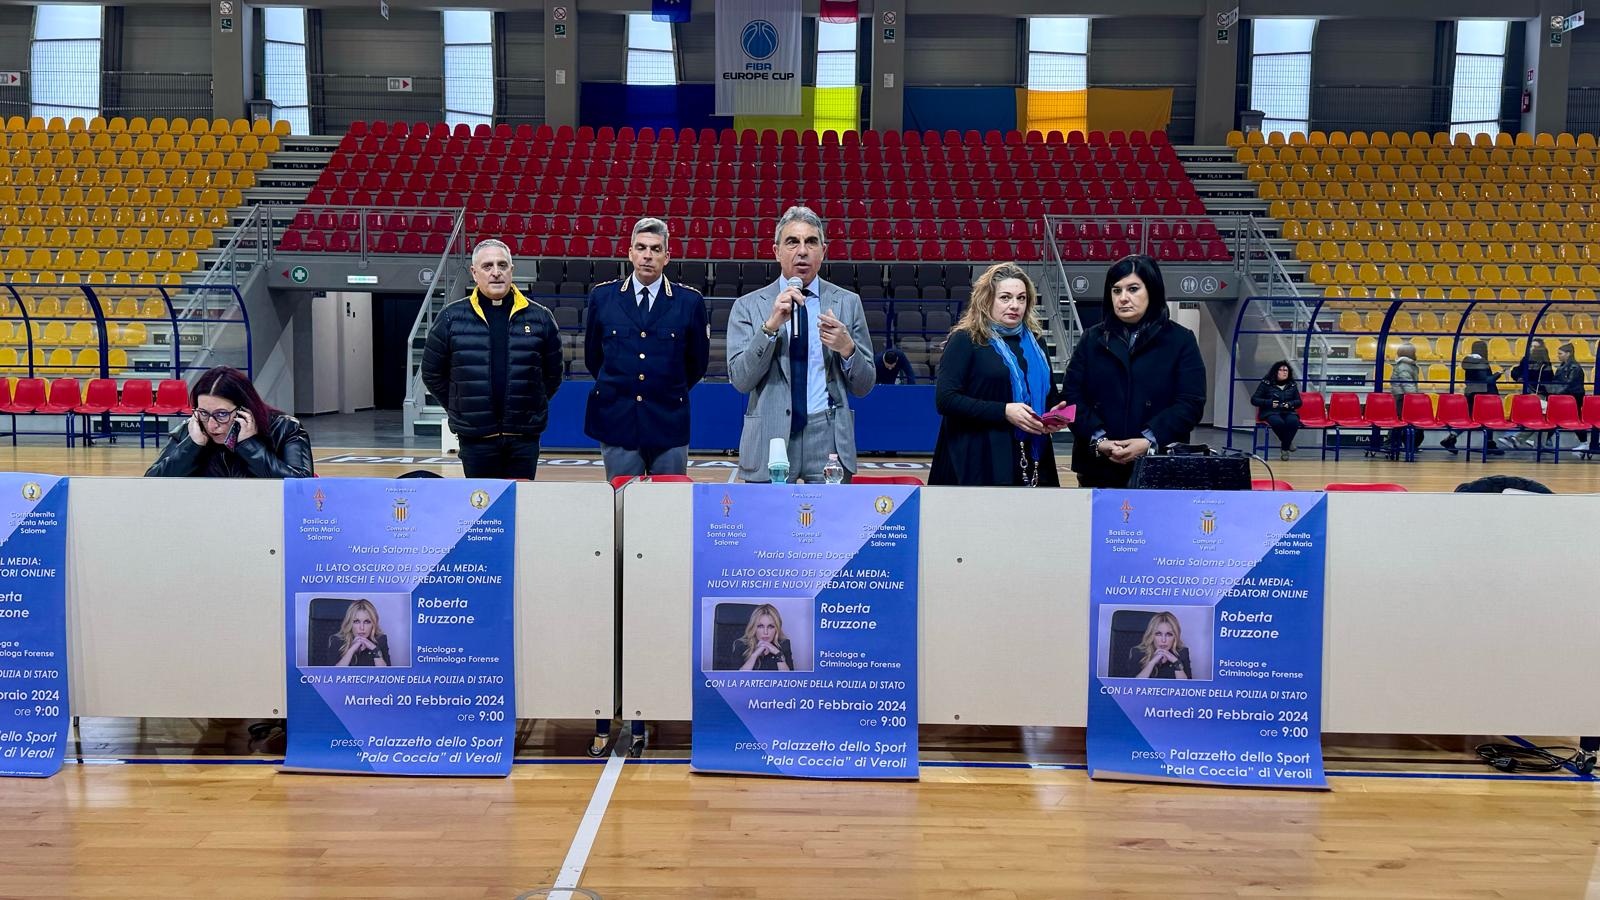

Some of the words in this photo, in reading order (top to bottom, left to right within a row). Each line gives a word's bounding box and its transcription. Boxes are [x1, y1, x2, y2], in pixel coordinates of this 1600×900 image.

[21, 569, 55, 577] ONLINE
[316, 564, 323, 572] IL
[326, 564, 350, 572] LATO
[353, 564, 395, 572] OSCURO
[398, 564, 412, 572] DEI
[415, 564, 451, 572] SOCIAL
[453, 564, 488, 572] MEDIA:
[721, 569, 729, 577] IL
[731, 569, 755, 577] LATO
[758, 569, 799, 577] OSCURO
[801, 569, 816, 577] DEI
[818, 569, 854, 578] SOCIAL
[857, 570, 890, 578] MEDIA:
[301, 576, 334, 584] NUOVI
[337, 576, 368, 584] RISCHI
[370, 576, 375, 584] E
[378, 576, 410, 584] NUOVI
[413, 576, 464, 584] PREDATORI
[467, 576, 502, 584] ONLINE
[707, 580, 739, 588] NUOVI
[741, 580, 772, 589] RISCHI
[774, 581, 779, 589] E
[782, 581, 813, 589] NUOVI
[816, 581, 866, 589] PREDATORI
[869, 581, 904, 590] ONLINE
[1120, 576, 1127, 584] IL
[1130, 576, 1154, 584] LATO
[1157, 576, 1199, 585] OSCURO
[1202, 577, 1217, 585] DEI
[1220, 577, 1256, 586] SOCIAL
[1259, 578, 1293, 586] MEDIA:
[1105, 587, 1137, 596] NUOVI
[1140, 588, 1172, 596] RISCHI
[1174, 588, 1179, 596] E
[1182, 588, 1214, 597] NUOVI
[1217, 589, 1269, 598] PREDATORI
[1272, 589, 1308, 598] ONLINE
[418, 598, 468, 609] Roberta
[820, 603, 870, 614] Roberta
[418, 613, 474, 624] Bruzzone
[1221, 611, 1272, 623] Roberta
[820, 619, 877, 630] Bruzzone
[1220, 627, 1279, 639] Bruzzone
[418, 646, 456, 654] Psicologa
[820, 651, 858, 659] Psicologa
[418, 655, 466, 664] Criminologa
[469, 655, 499, 663] Forense
[820, 660, 868, 669] Criminologa
[24, 670, 31, 678] DI
[34, 670, 58, 678] STATO
[300, 676, 321, 684] CON
[323, 676, 334, 684] LA
[336, 676, 405, 684] PARTECIPAZIONE
[408, 676, 431, 684] DELLA
[434, 676, 465, 684] POLIZIA
[468, 676, 476, 684] DI
[478, 676, 503, 684] STATO
[32, 690, 59, 700] 2024
[1100, 687, 1121, 695] CON
[1123, 687, 1133, 695] LA
[1136, 687, 1206, 696] PARTECIPAZIONE
[1209, 689, 1233, 698] DELLA
[1236, 690, 1268, 699] POLIZIA
[1270, 691, 1279, 699] DI
[1281, 691, 1308, 700] STATO
[345, 694, 393, 706] Martedì
[397, 696, 411, 706] 20
[416, 695, 471, 706] Febbraio
[475, 695, 504, 706] 2024
[748, 698, 797, 710] Martedì
[800, 699, 814, 710] 20
[818, 699, 873, 711] Febbraio
[877, 700, 906, 711] 2024
[15, 708, 31, 716] ore
[35, 706, 59, 716] 9:00
[457, 713, 474, 721] ore
[479, 711, 504, 721] 9:00
[1144, 706, 1194, 719] Martedì
[1198, 709, 1213, 719] 20
[1217, 709, 1274, 721] Febbraio
[1278, 711, 1308, 722] 2024
[860, 718, 877, 727] ore
[881, 717, 906, 727] 9:00
[26, 732, 57, 744] Sport
[331, 738, 364, 748] presso
[368, 736, 432, 747] Palazzetto
[436, 736, 466, 747] dello
[471, 736, 503, 749] Sport
[4, 747, 16, 757] di
[20, 748, 55, 758] Veroli
[450, 752, 461, 763] di
[465, 752, 501, 763] Veroli
[1132, 751, 1165, 760] presso
[1170, 749, 1236, 761] Palazzetto
[1241, 751, 1273, 763] dello
[1277, 752, 1310, 764] Sport
[1259, 767, 1270, 778] di
[1274, 768, 1312, 779] Veroli
